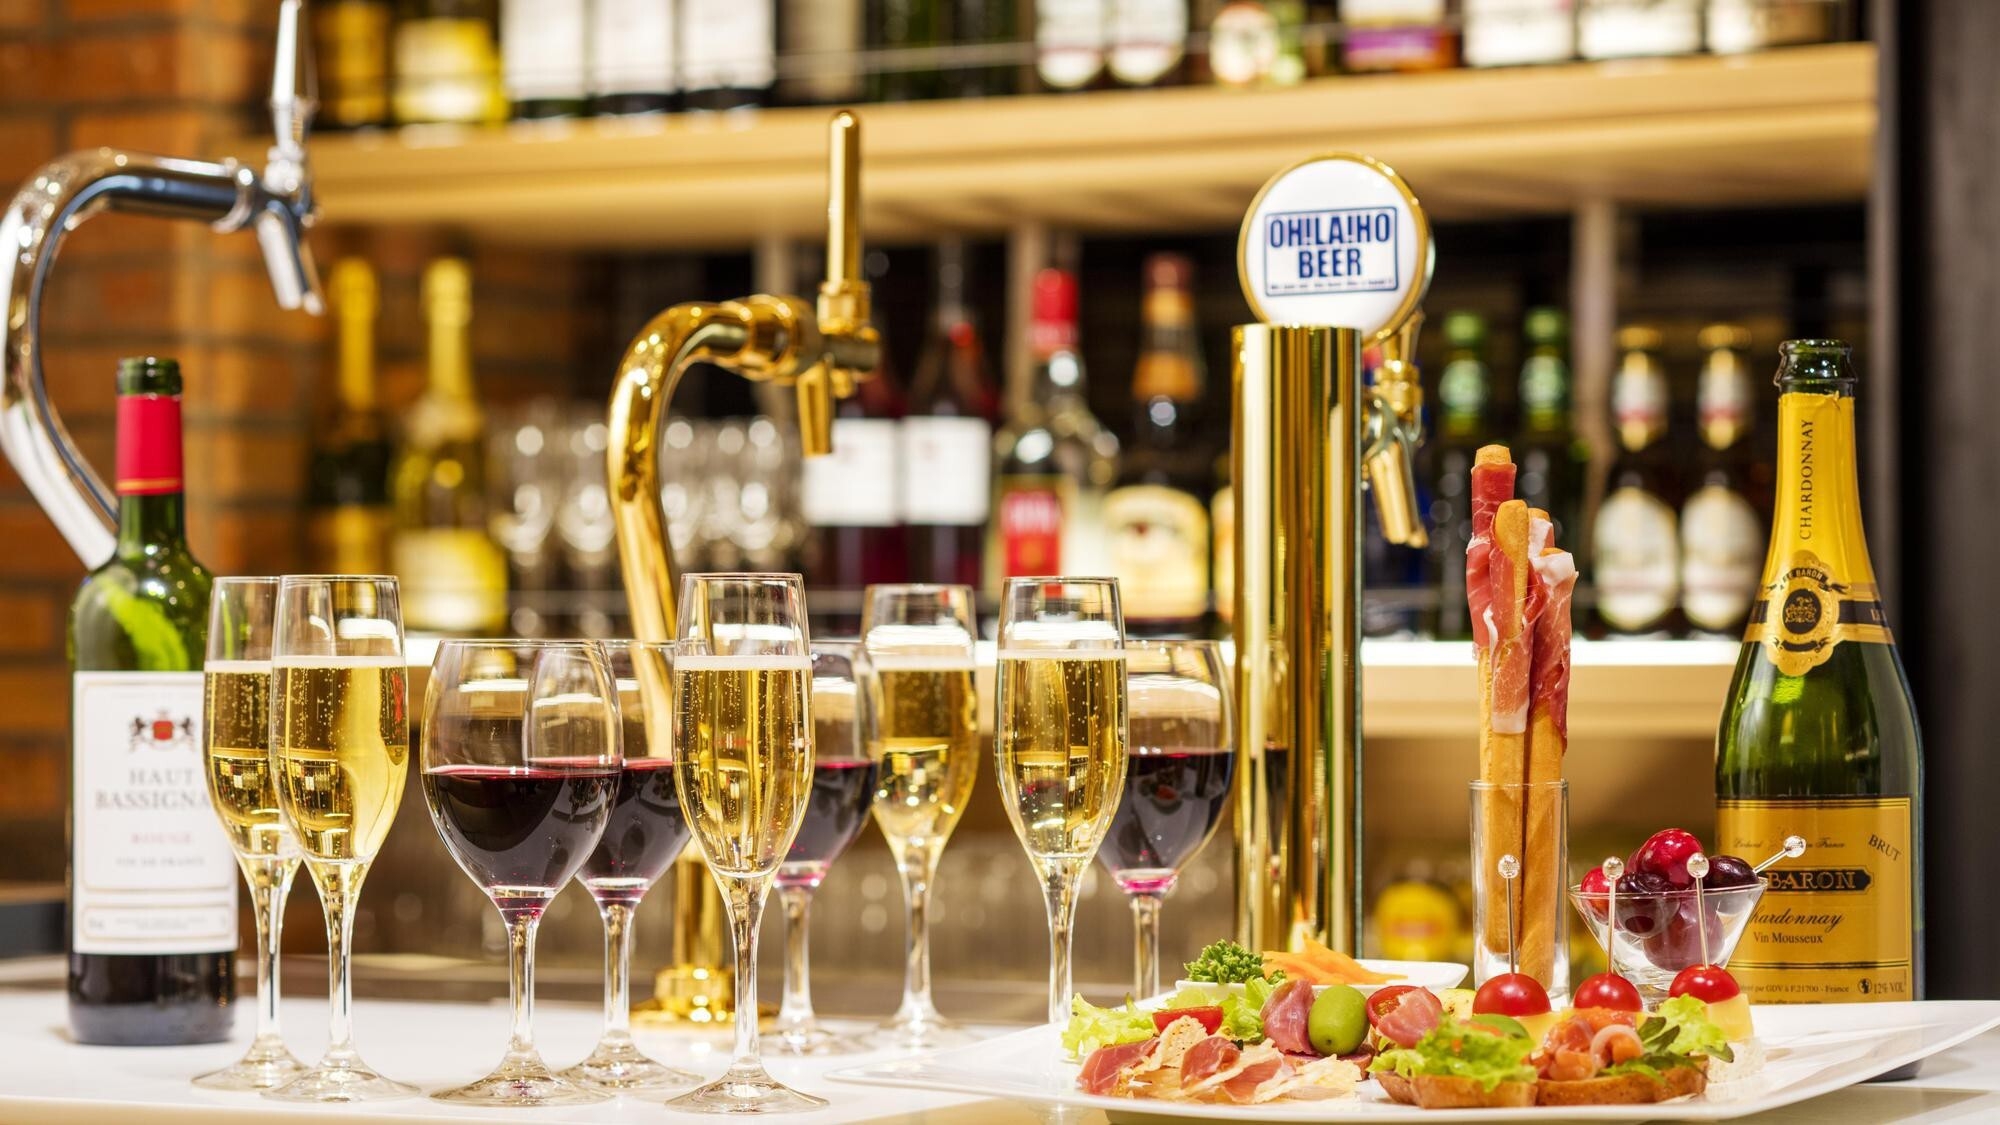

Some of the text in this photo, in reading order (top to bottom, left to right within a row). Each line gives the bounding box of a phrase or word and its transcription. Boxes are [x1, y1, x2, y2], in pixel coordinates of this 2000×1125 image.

[1270, 213, 1391, 248] OH!LA!HO
[1298, 248, 1362, 279] BEER
[1800, 419, 1814, 540] CHARDONNAY
[129, 768, 195, 786] HAUT
[95, 789, 212, 811] BASSIGNA
[1868, 834, 1901, 861] BRUT
[1766, 871, 1856, 889] BARON
[1752, 905, 1843, 933] hardonnay
[1753, 931, 1824, 944] Vin Mousseux
[1825, 983, 1849, 993] France
